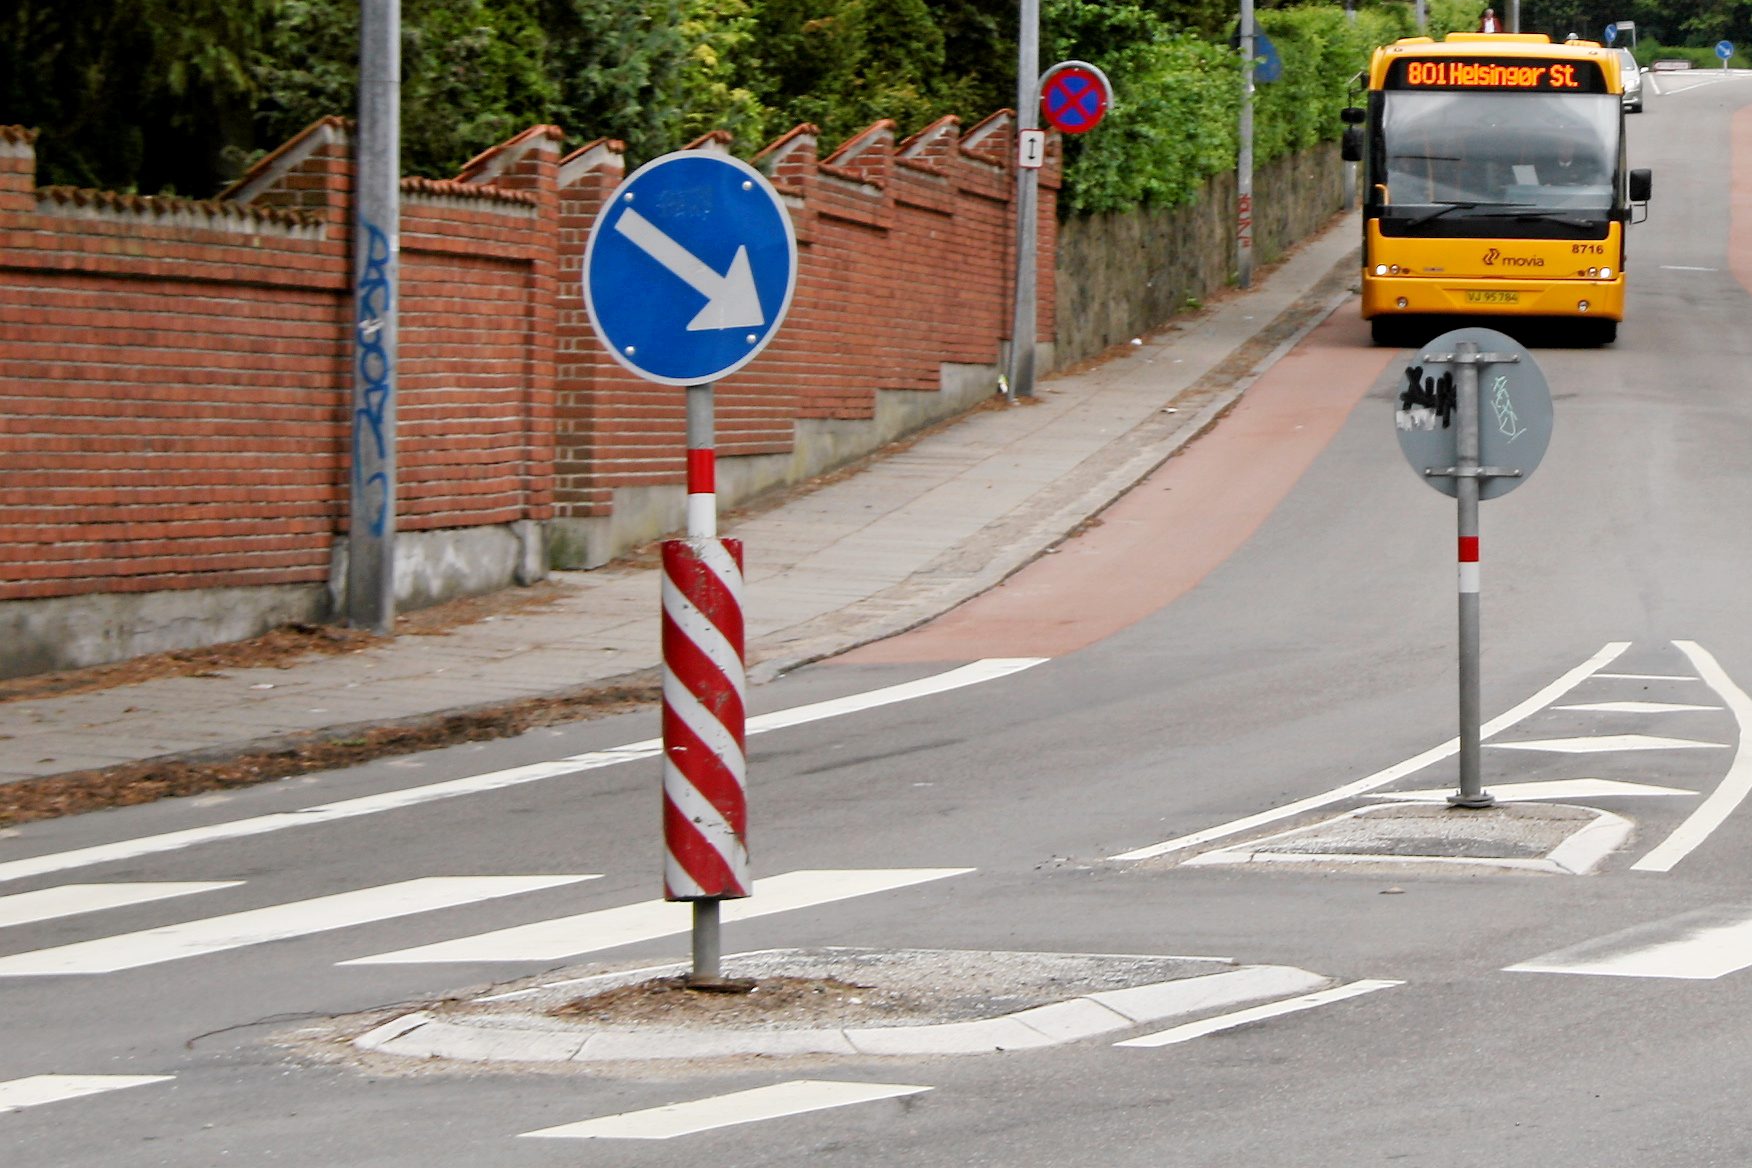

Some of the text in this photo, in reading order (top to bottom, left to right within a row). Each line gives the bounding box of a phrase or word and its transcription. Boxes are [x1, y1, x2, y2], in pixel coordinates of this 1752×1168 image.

[1408, 62, 1579, 87] 801 Helsingør St.
[1571, 244, 1604, 254] 8716
[1502, 255, 1544, 266] movia
